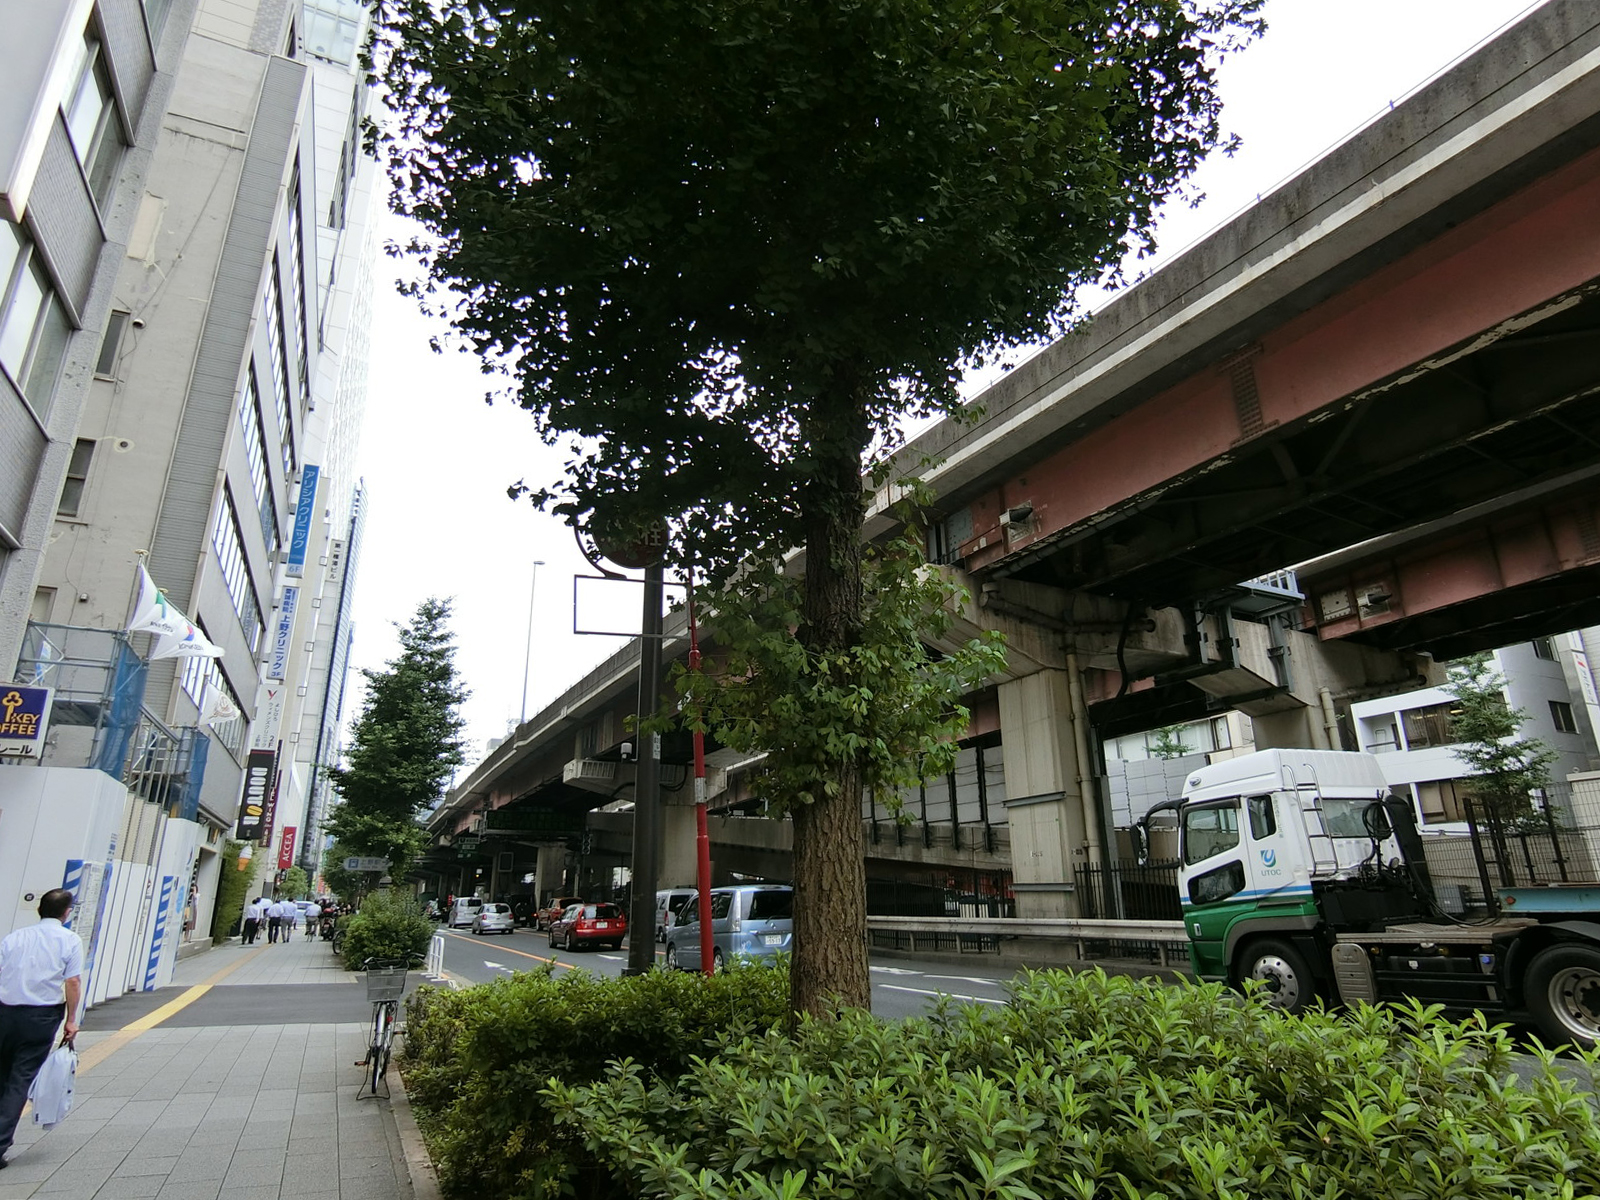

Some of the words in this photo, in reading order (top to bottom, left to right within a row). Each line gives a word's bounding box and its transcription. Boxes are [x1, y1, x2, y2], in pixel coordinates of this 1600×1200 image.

[293, 470, 316, 549] アリシアクリニック
[288, 565, 301, 573] 6F
[273, 614, 291, 670] 上野クリニック
[11, 712, 41, 724] KEY
[0, 723, 37, 736] FFEE
[242, 767, 268, 825] DOUTOR
[282, 833, 294, 862] ACCEA
[1261, 869, 1281, 877] UTOC
